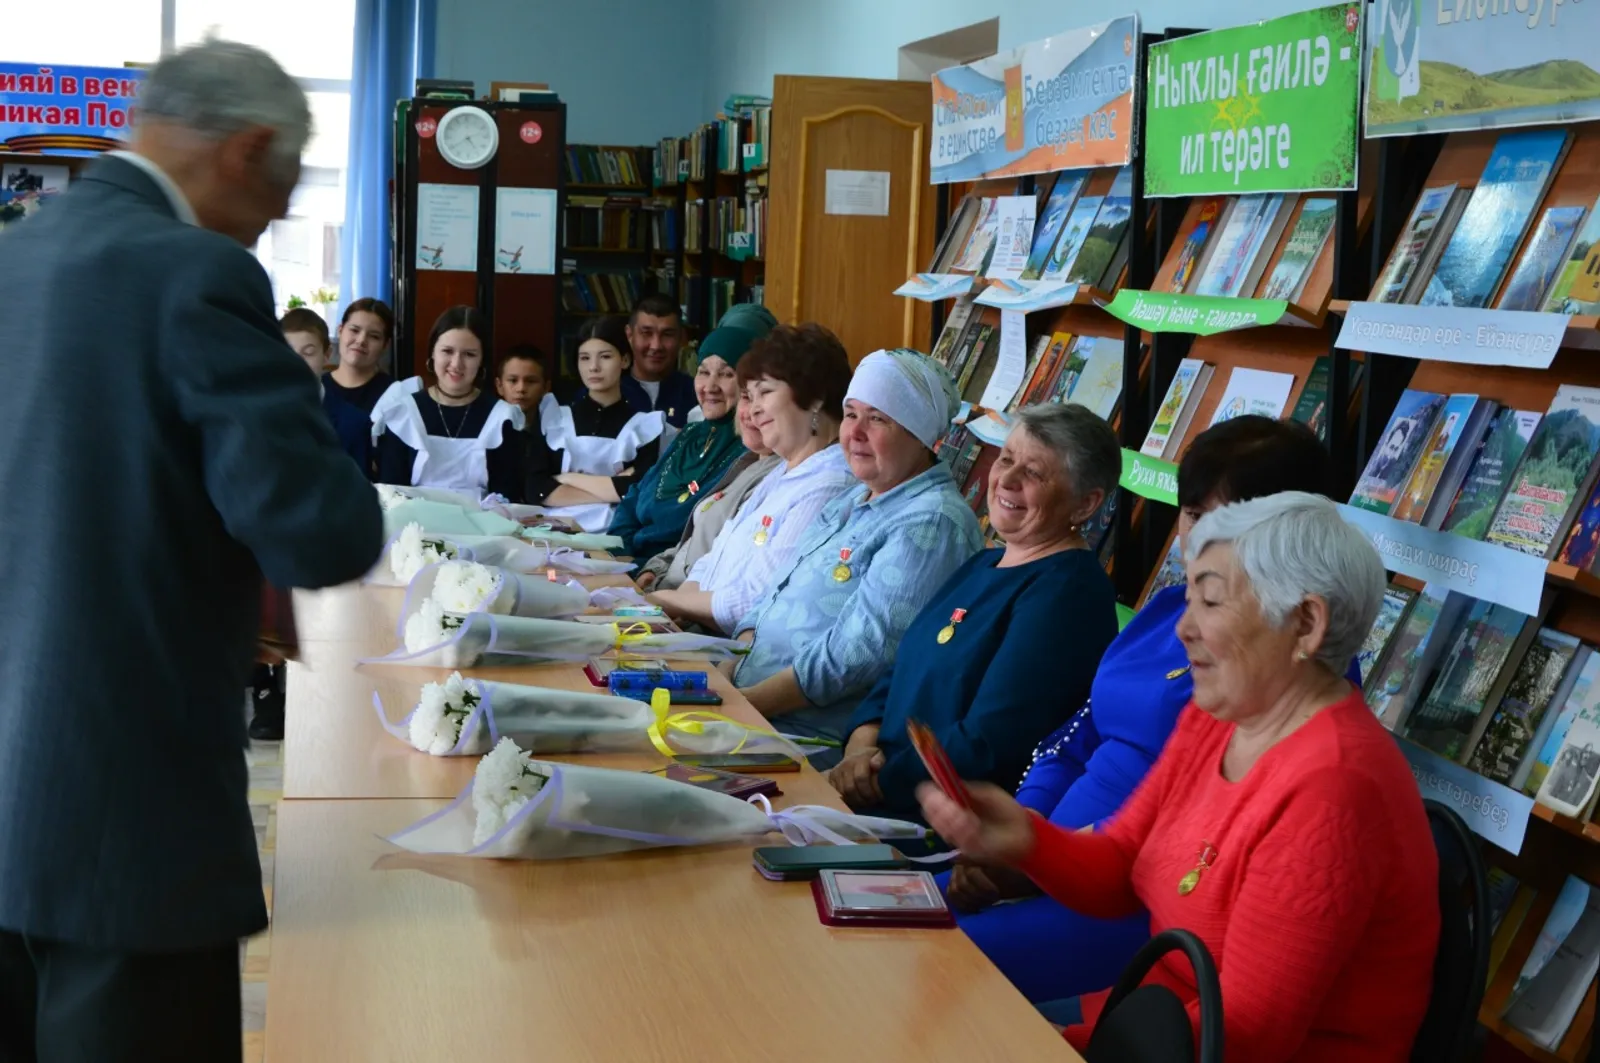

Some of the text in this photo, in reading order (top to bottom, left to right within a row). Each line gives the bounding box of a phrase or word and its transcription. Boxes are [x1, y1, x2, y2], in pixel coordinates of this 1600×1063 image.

[1154, 52, 1240, 108] Ныҡлы
[1246, 35, 1331, 95] ғаилә
[60, 75, 78, 96] в
[521, 127, 540, 137] 12+
[939, 135, 945, 158] в
[1179, 123, 1291, 185] ил терәге
[1434, 326, 1462, 348] ере
[1128, 459, 1156, 486] Рухи
[1373, 532, 1424, 565] Ижади
